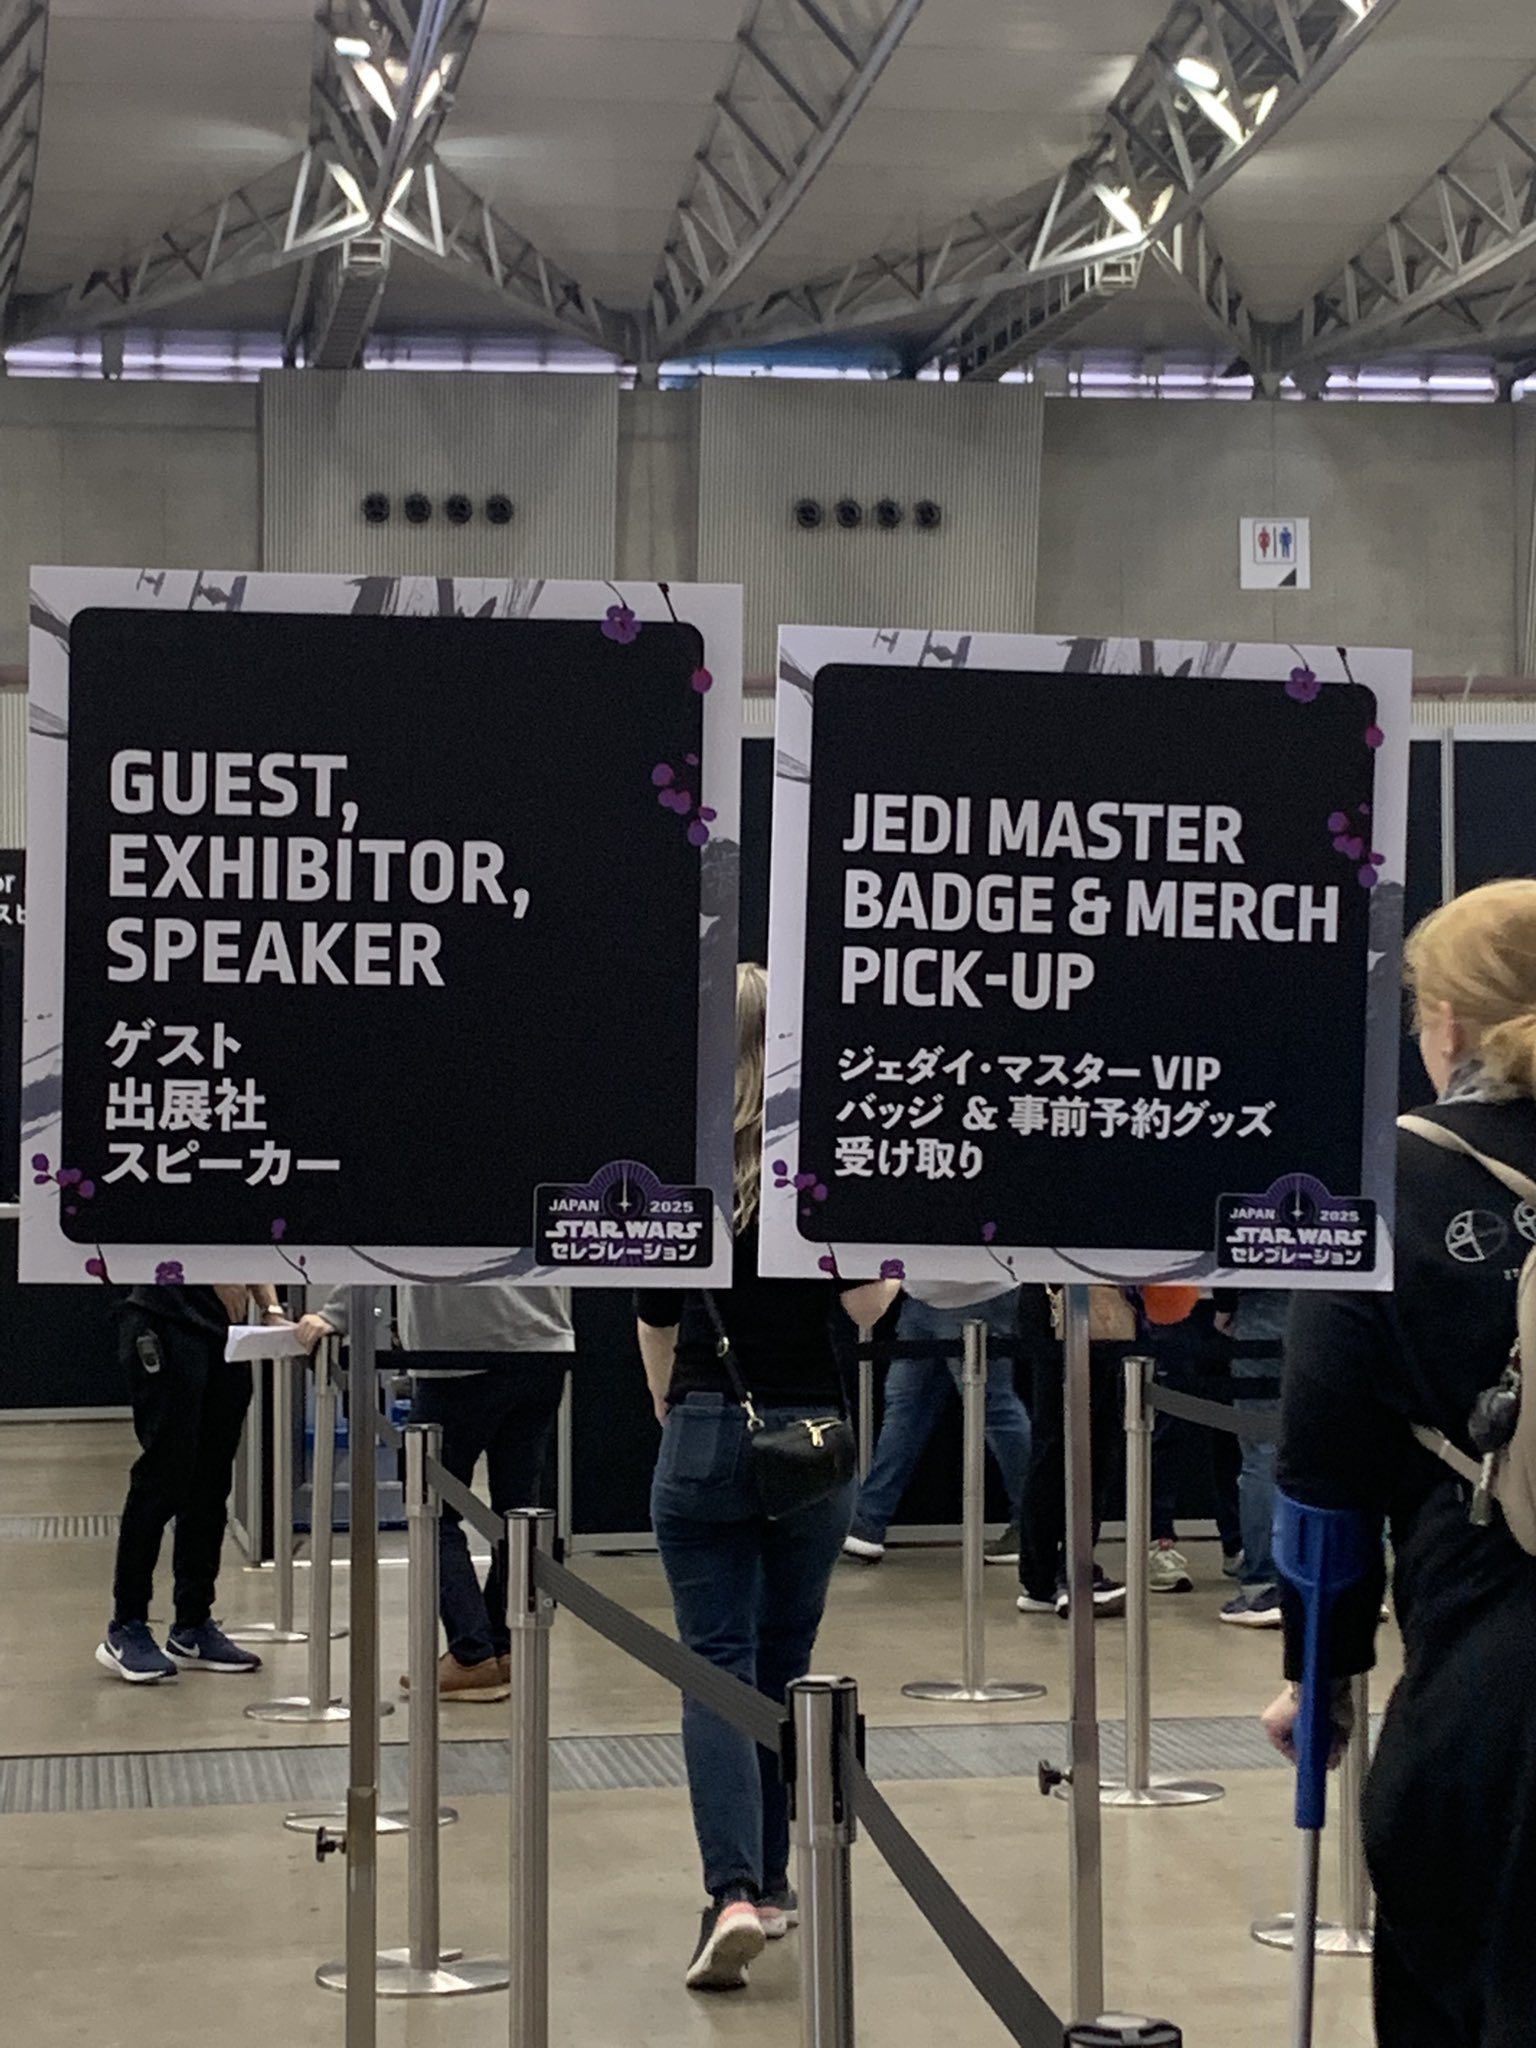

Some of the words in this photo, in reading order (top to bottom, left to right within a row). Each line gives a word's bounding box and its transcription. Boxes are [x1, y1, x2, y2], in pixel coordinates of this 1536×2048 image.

[110, 749, 359, 833] GUEST,
[842, 793, 971, 855] JEDI
[988, 798, 1245, 864] MASTER
[109, 833, 530, 922] EXHIBITOR,
[844, 869, 1054, 934] BADGE
[1068, 877, 1112, 936] &
[1126, 879, 1339, 943] MERCH
[106, 917, 445, 986] SPEAKER
[841, 946, 1095, 1011] PICK-UP
[105, 1017, 242, 1070] ゲスト
[838, 1045, 1141, 1090] ジェダイ・マスター
[1151, 1054, 1221, 1091] VIP
[105, 1076, 267, 1132] 出展社
[835, 1092, 945, 1130] バッジ
[962, 1095, 999, 1131] &
[1007, 1094, 1277, 1140] 事前予約グッズ
[101, 1139, 340, 1186] スピーカー
[834, 1135, 983, 1180] 受け取り
[549, 1198, 600, 1212] JAPAN
[649, 1200, 694, 1213] 2025
[1230, 1207, 1276, 1220] JAPAN
[1319, 1210, 1360, 1222] 2025
[545, 1220, 624, 1239] STAR
[624, 1220, 703, 1240] WARS
[551, 1241, 697, 1261] セレブレーション
[1225, 1226, 1297, 1245] STAR
[1296, 1228, 1367, 1246] WARS
[1230, 1246, 1362, 1265] セレブレーション
